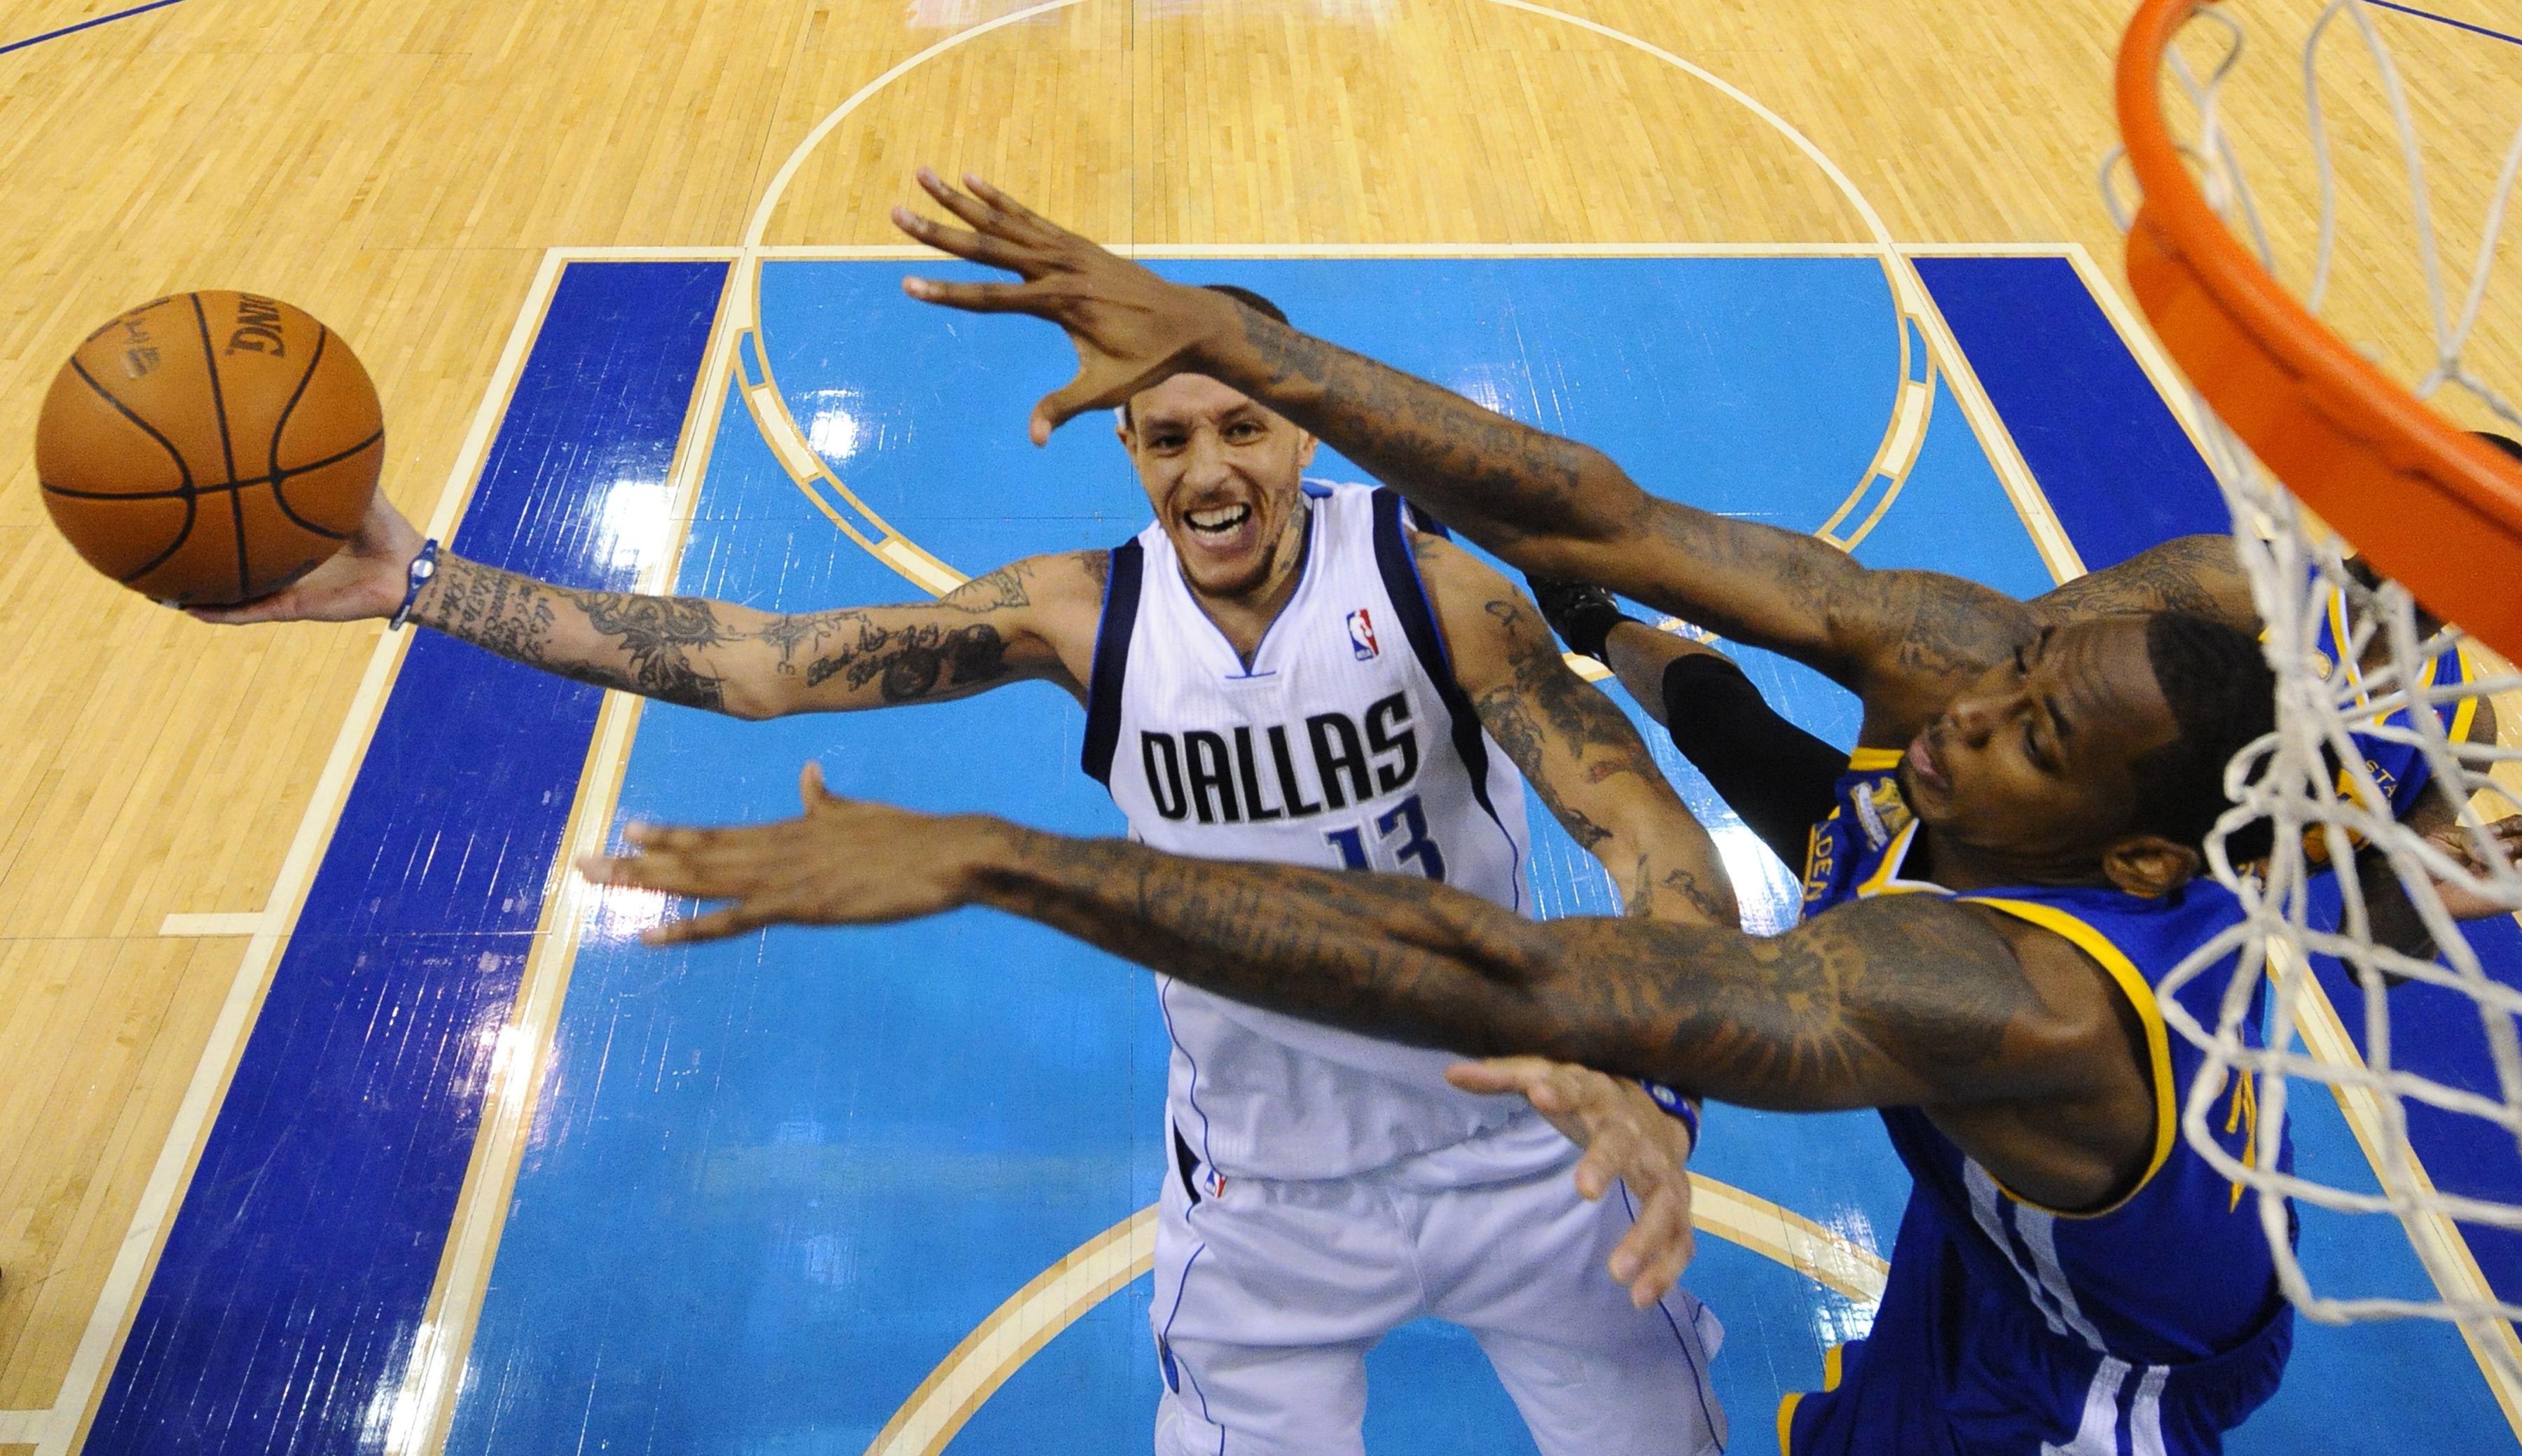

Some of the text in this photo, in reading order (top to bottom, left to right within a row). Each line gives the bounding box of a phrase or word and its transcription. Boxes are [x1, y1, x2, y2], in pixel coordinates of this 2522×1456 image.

[1141, 690, 1419, 824] DALLAS
[2365, 760, 2398, 810] STA
[1325, 793, 1447, 883] 13
